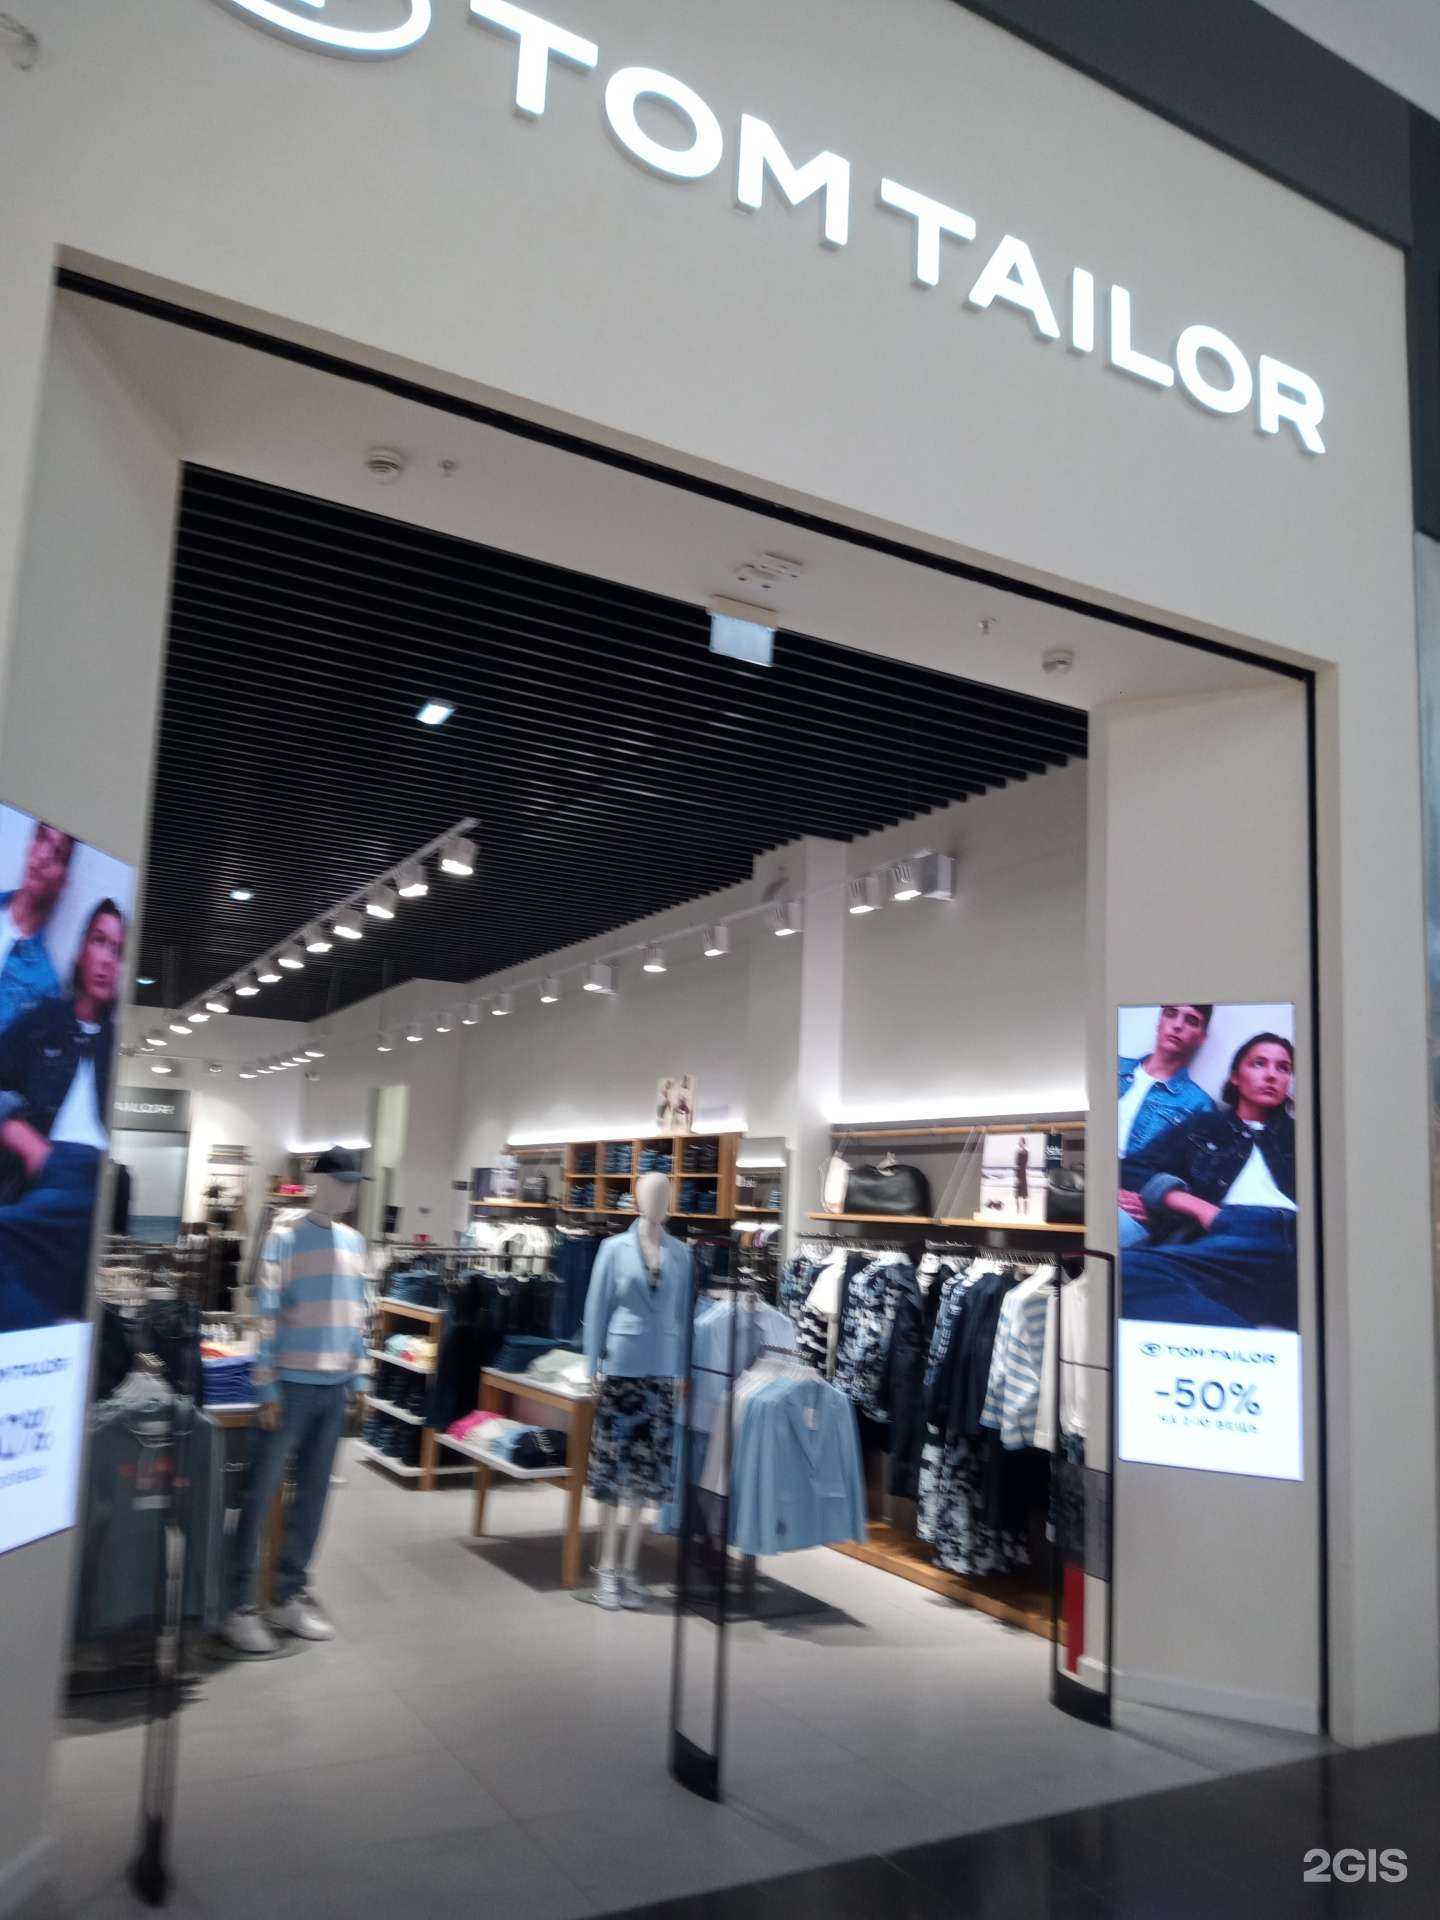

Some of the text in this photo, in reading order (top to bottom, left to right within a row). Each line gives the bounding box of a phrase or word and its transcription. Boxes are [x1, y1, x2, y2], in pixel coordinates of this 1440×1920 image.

[470, 0, 1327, 455] TOM TAILOR
[1166, 1343, 1277, 1365] TOM TAILOR
[1155, 1377, 1262, 1415] -50%
